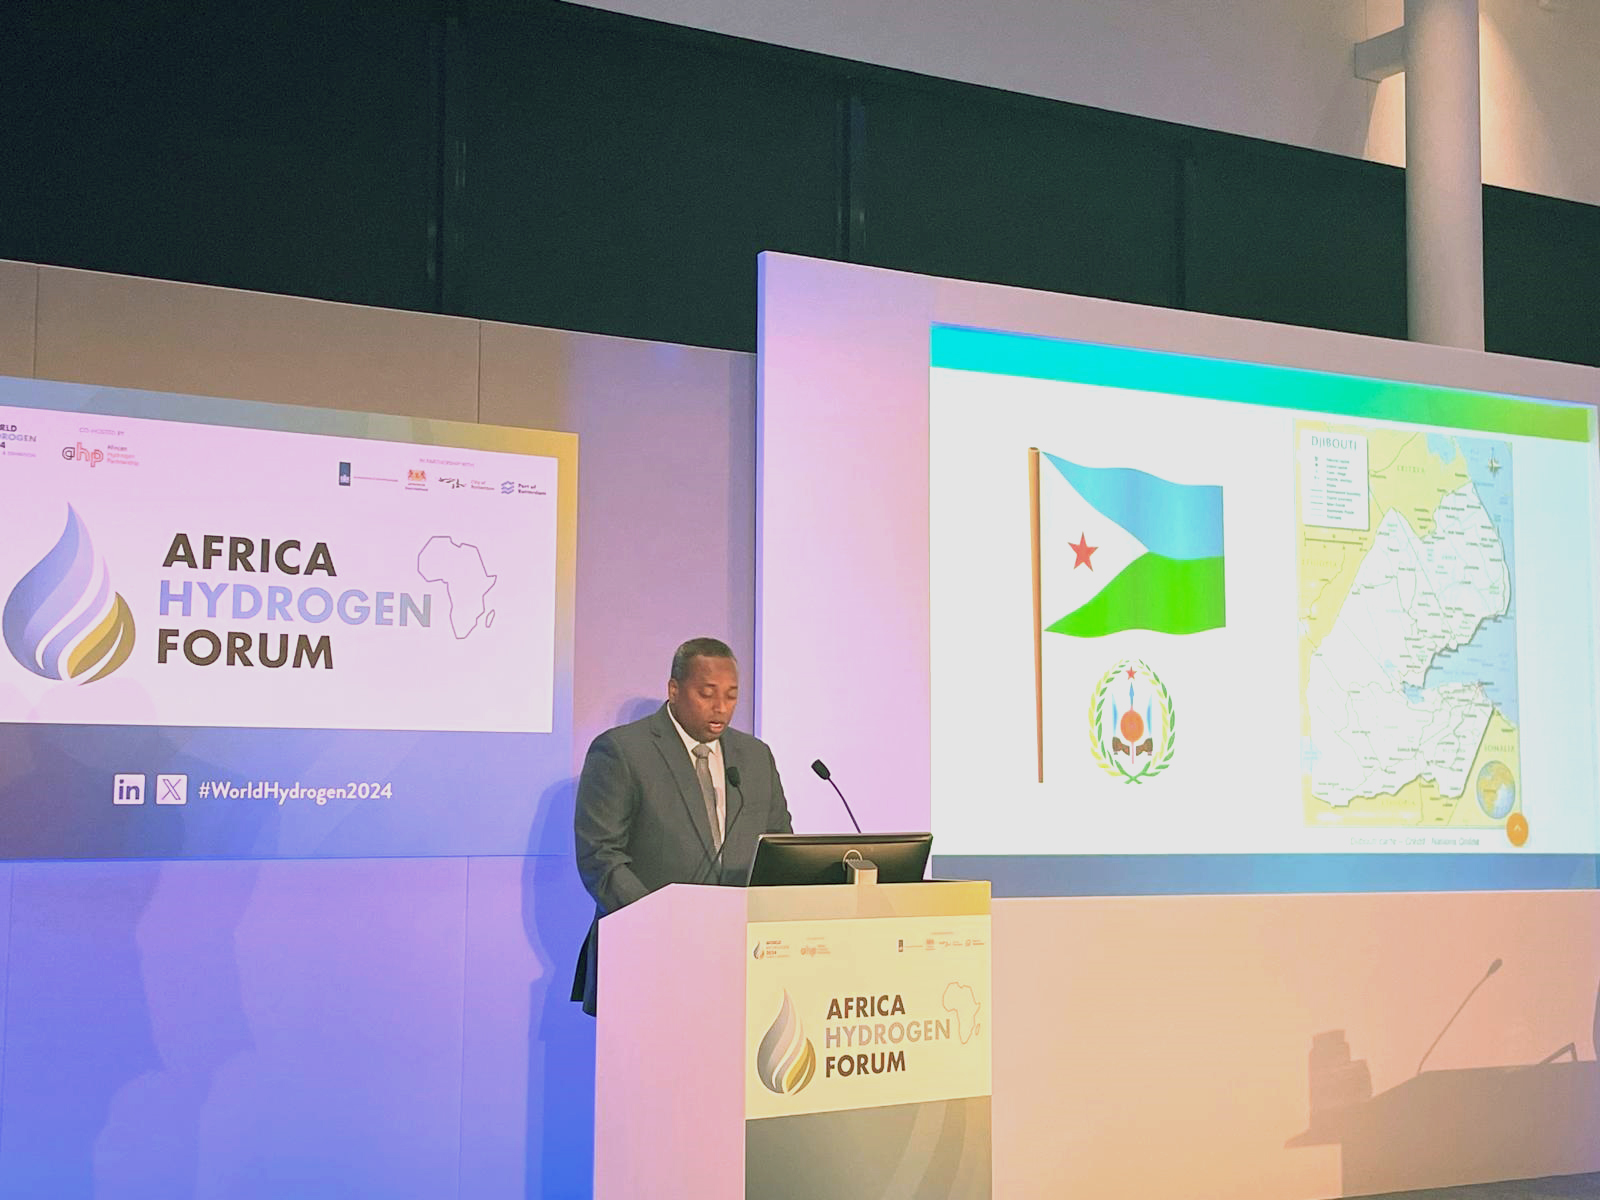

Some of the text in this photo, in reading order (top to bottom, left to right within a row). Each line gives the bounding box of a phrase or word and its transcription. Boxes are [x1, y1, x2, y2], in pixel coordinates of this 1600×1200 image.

[0, 424, 17, 432] RLD
[0, 432, 37, 442] ROGEN
[1311, 435, 1357, 451] DJIBOUTI
[162, 532, 337, 577] AFRICA
[159, 579, 432, 628] HYDROGEN
[157, 628, 334, 670] FORUM
[198, 781, 393, 806] #WorldHydrogen2024
[826, 994, 906, 1020] AFRICA
[825, 1018, 951, 1049] HYDROGEN
[825, 1050, 906, 1078] FORUM
